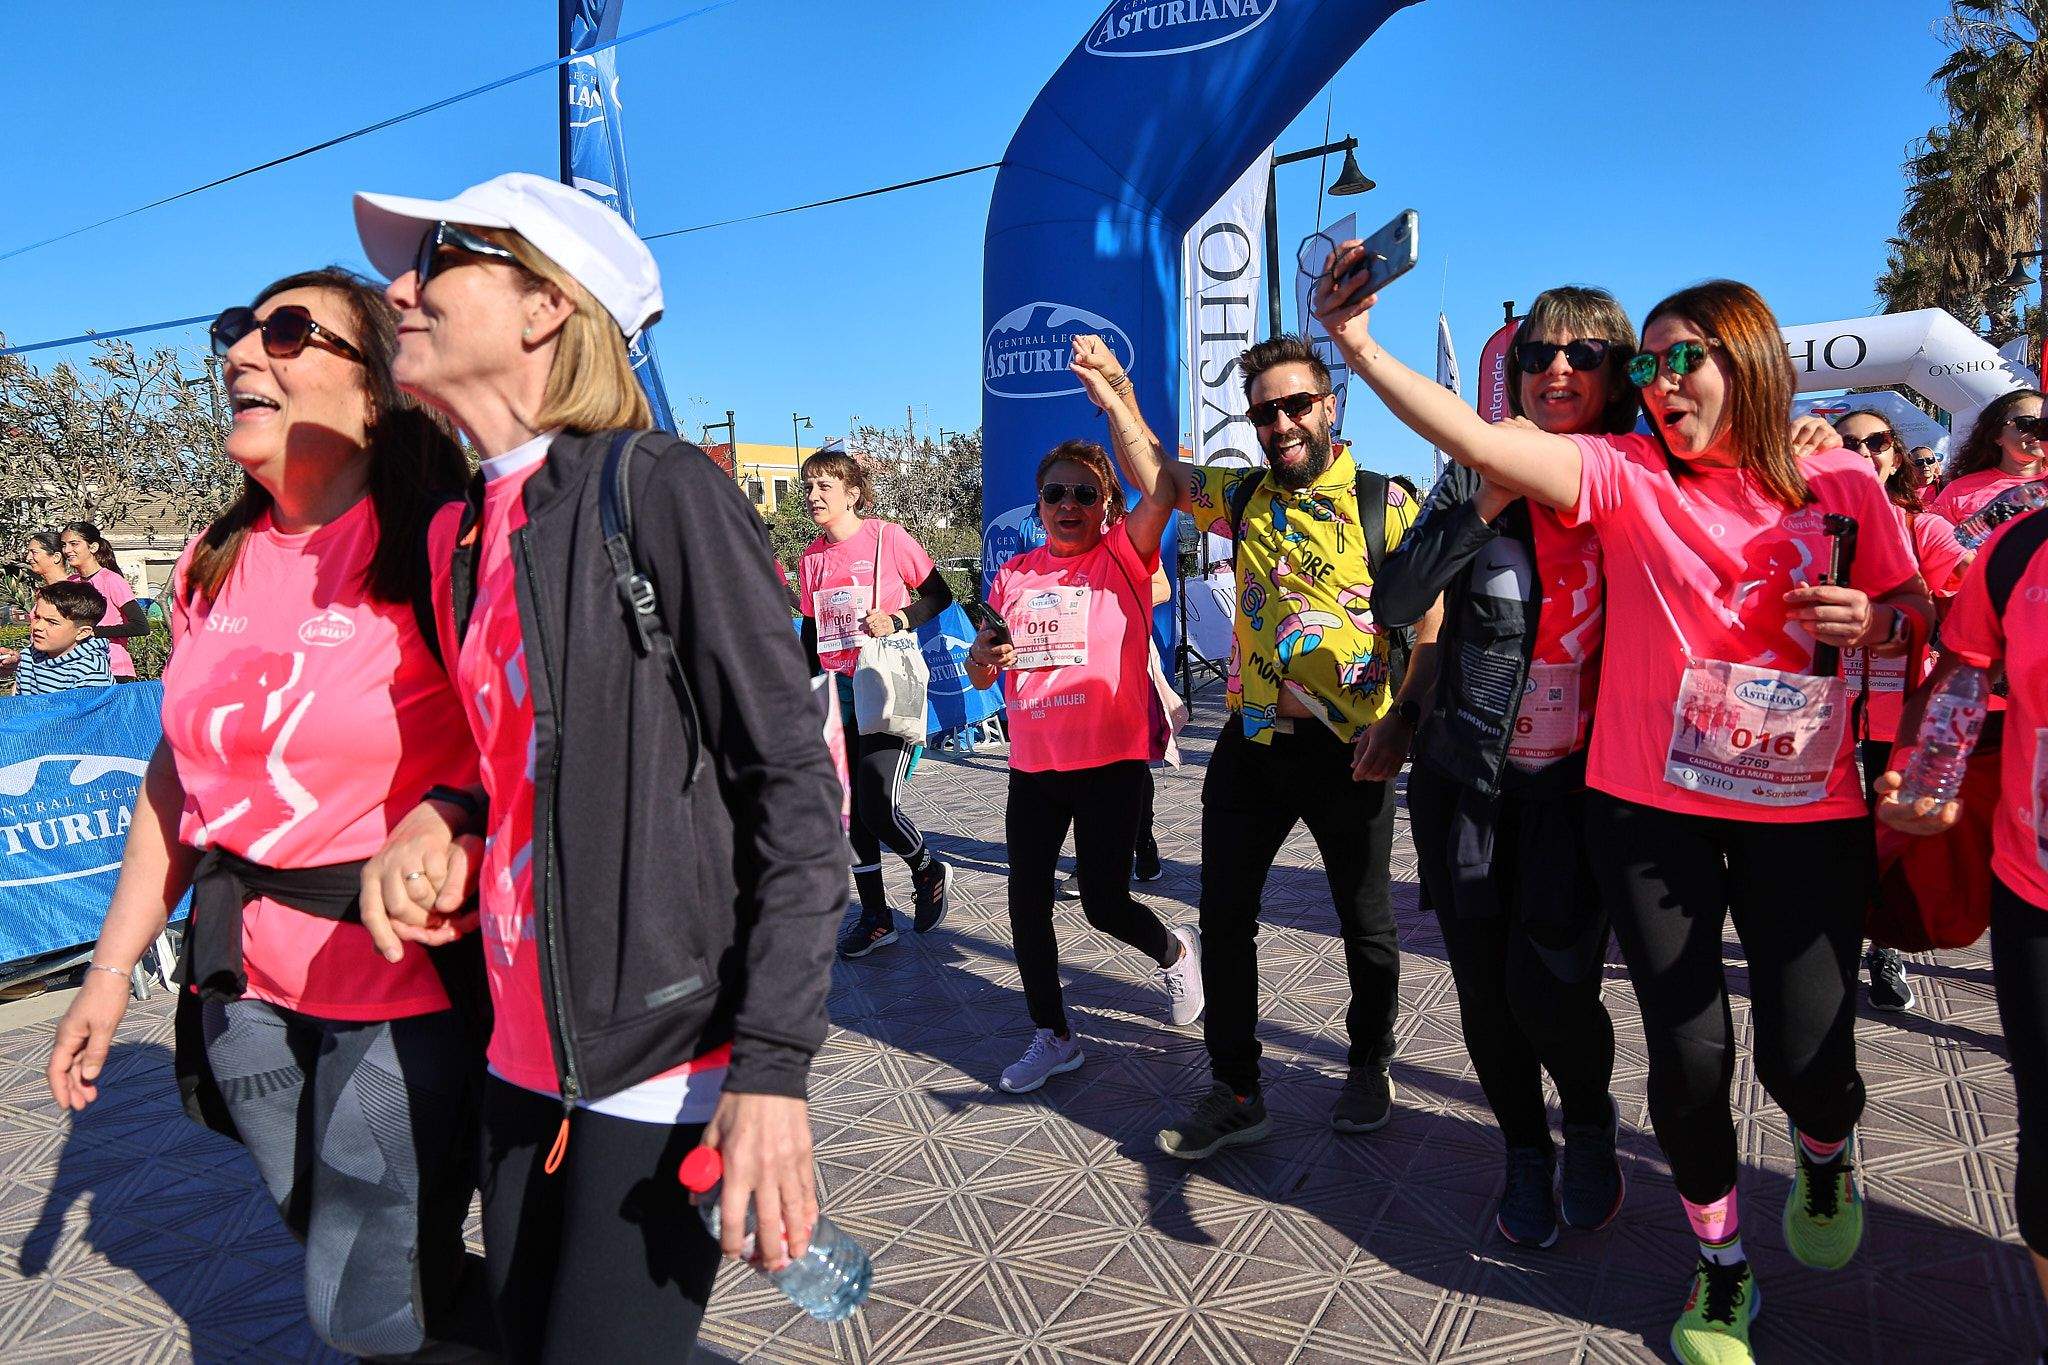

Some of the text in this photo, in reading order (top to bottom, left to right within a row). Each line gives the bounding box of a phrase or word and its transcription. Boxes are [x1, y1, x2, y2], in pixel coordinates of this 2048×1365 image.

[1094, 0, 1261, 48] ASTURIANA
[998, 334, 1046, 349] CENTRAL
[1928, 358, 1995, 377] OYSHO
[833, 613, 852, 627] 016
[1027, 620, 1059, 635] 016
[1054, 693, 1086, 707] MUJER
[1740, 686, 1802, 707] ASTURIANA
[1731, 728, 1796, 757] 016
[1689, 756, 1723, 770] CARRERA
[1724, 764, 1735, 773] DE
[1736, 767, 1747, 776] LA
[1747, 769, 1775, 782] MUJER
[1739, 756, 1770, 769] 2769
[1683, 768, 1809, 799] OYSHO Santander
